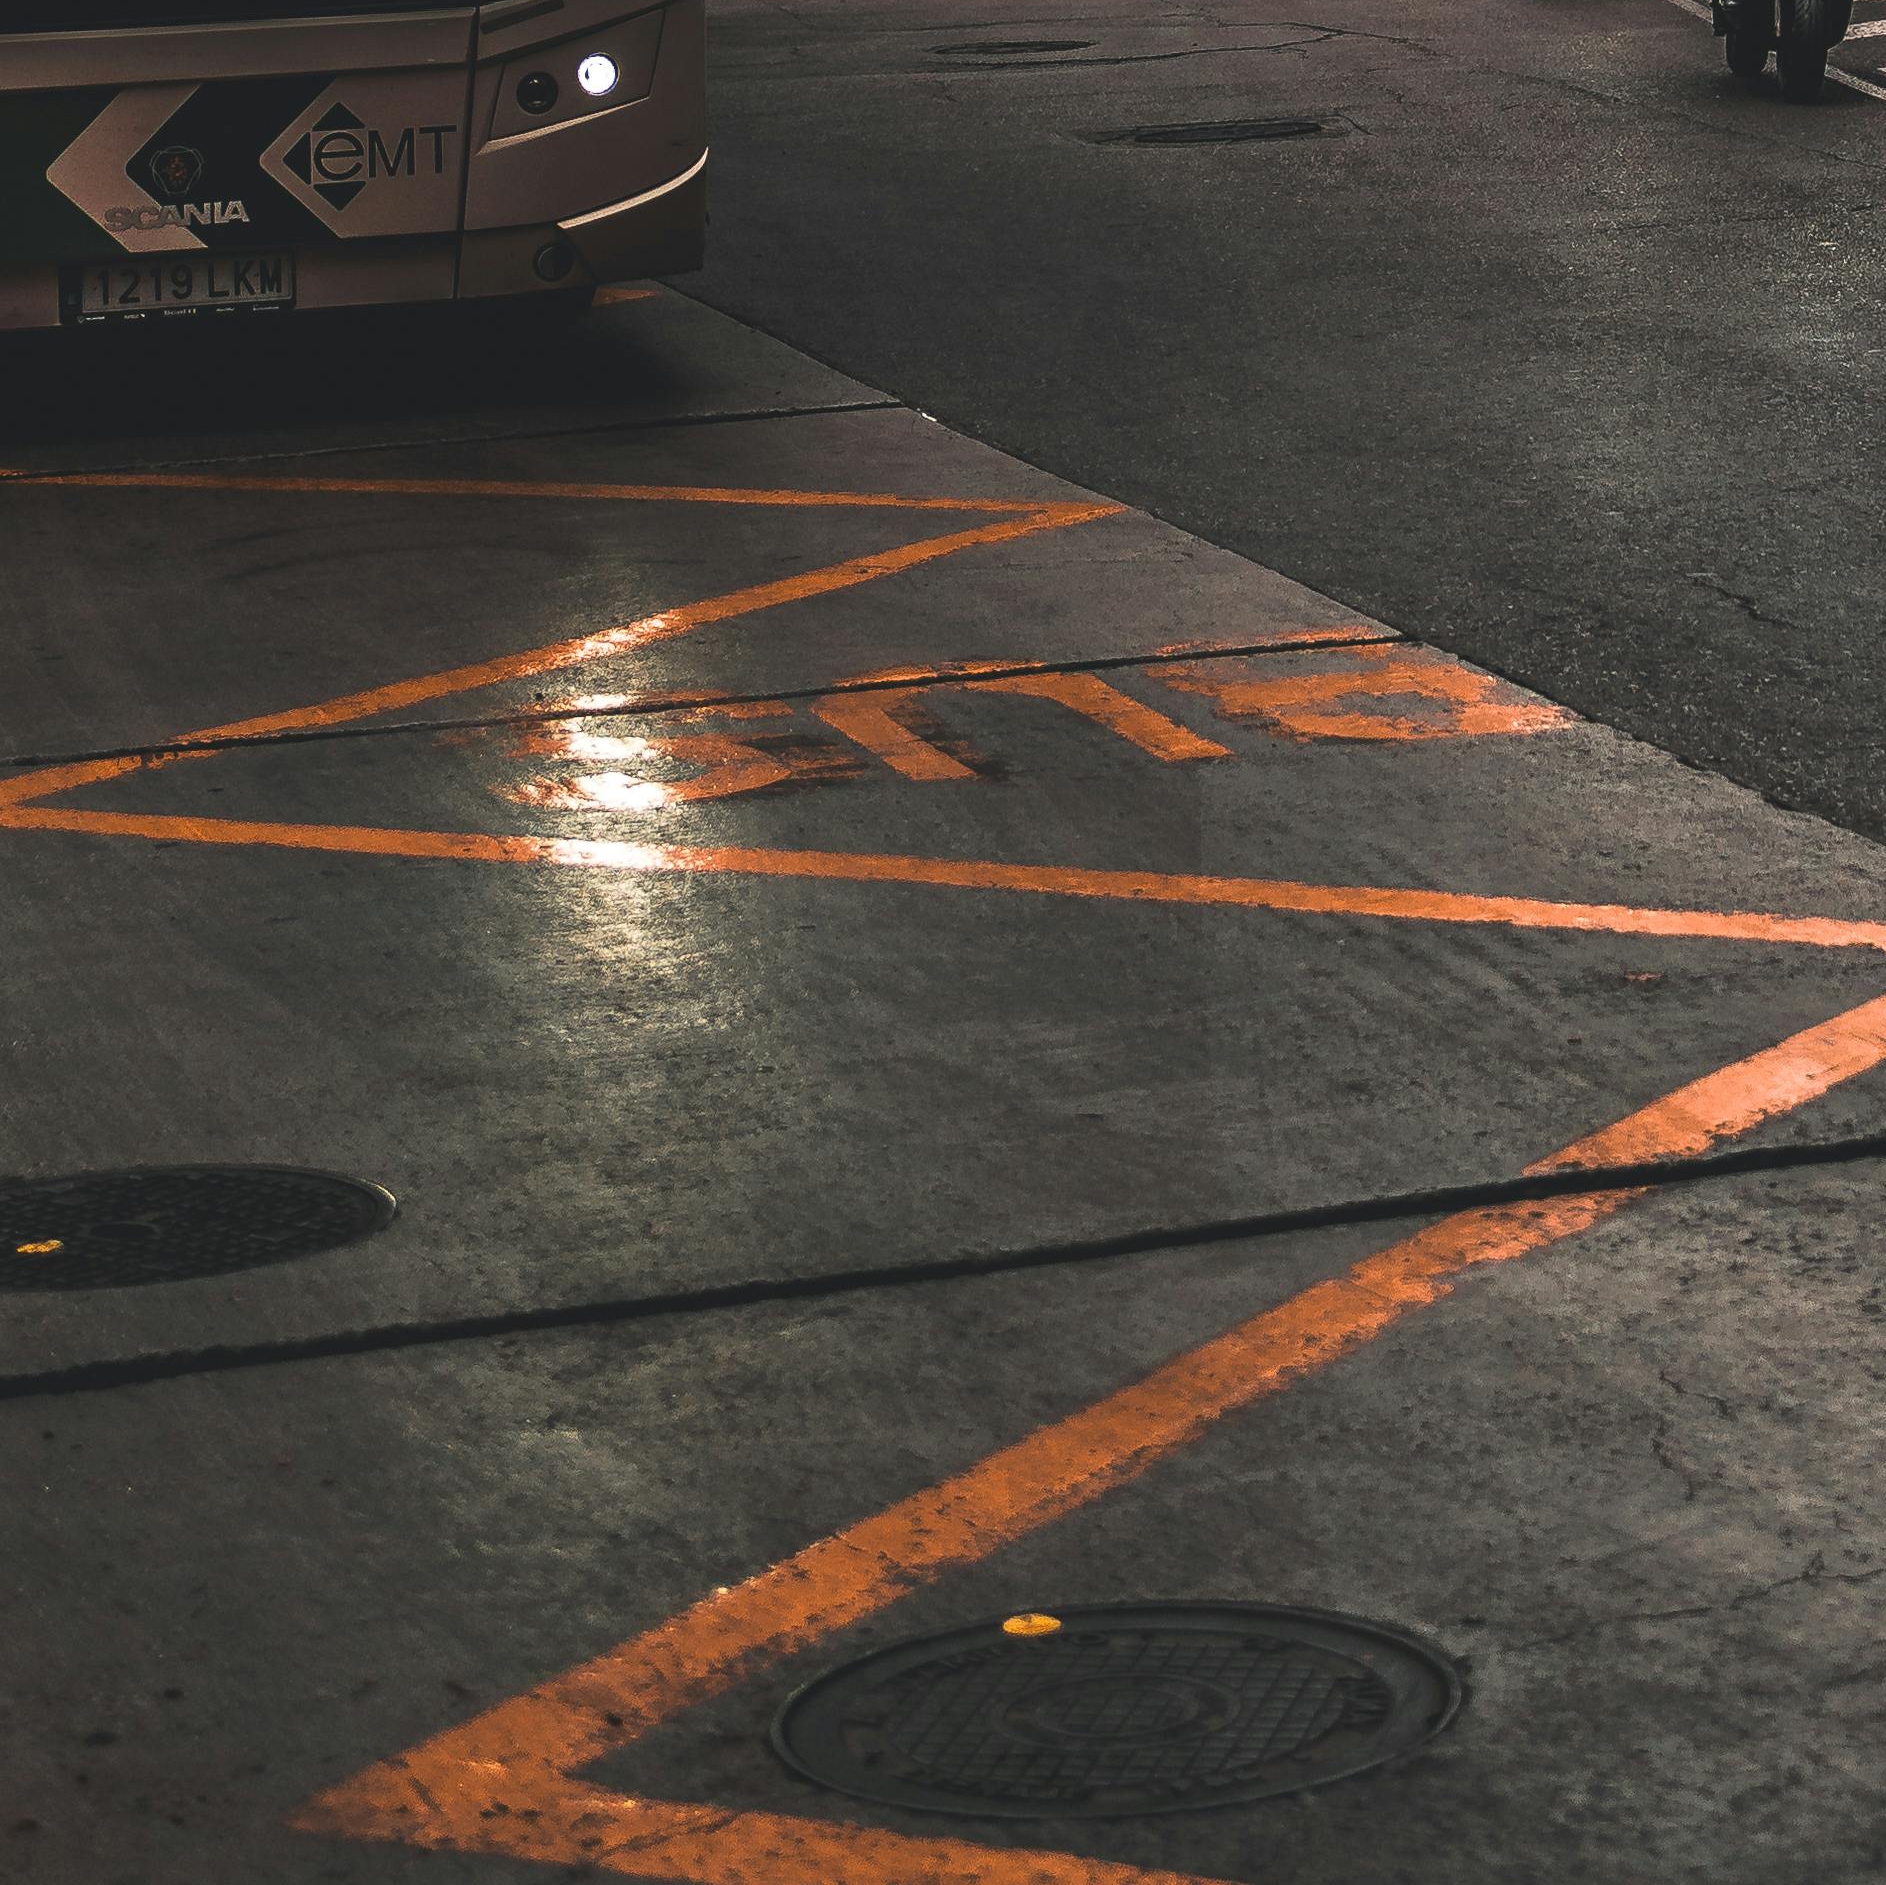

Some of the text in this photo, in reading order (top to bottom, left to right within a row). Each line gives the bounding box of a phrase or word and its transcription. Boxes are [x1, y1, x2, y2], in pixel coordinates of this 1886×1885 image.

[104, 199, 251, 232] SCANIA
[96, 255, 283, 305] 1219 LKM
